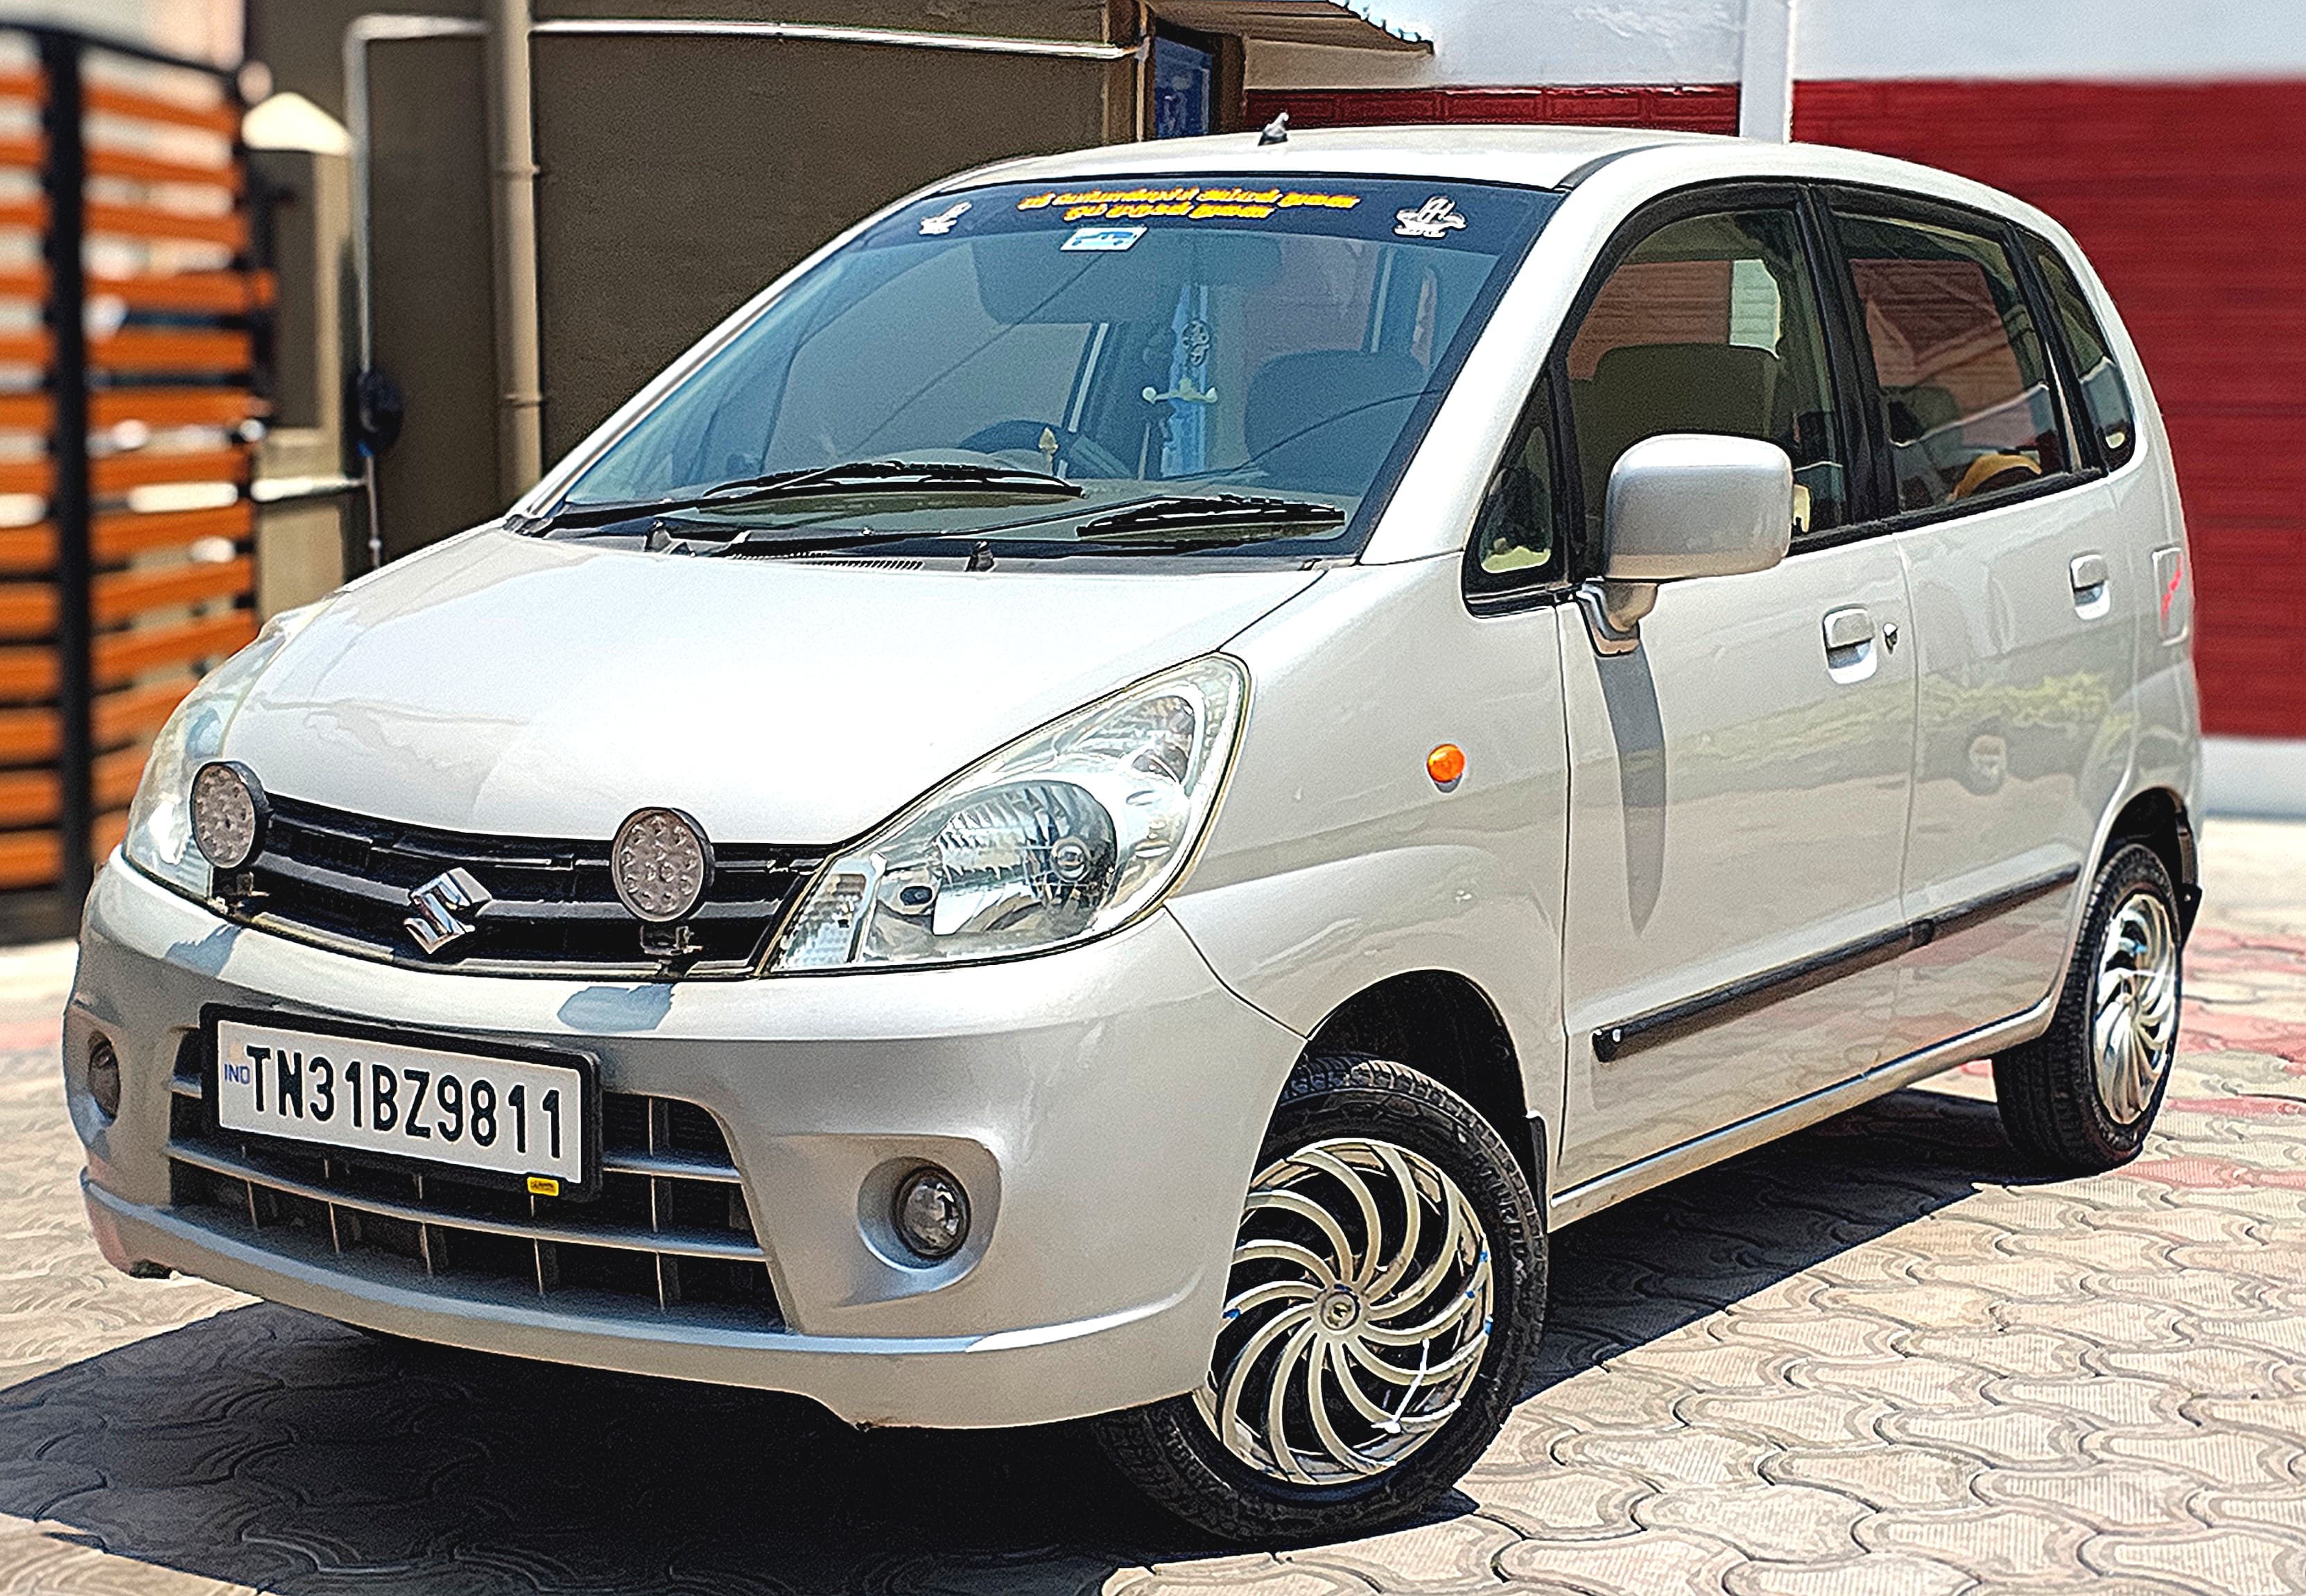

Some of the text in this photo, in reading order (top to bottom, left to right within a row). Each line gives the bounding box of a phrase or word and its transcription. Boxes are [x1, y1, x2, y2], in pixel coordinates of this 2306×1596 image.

[1277, 191, 1361, 208] துணை
[1105, 201, 1195, 218] முருகன்
[1188, 204, 1276, 220] துணை
[224, 1063, 251, 1085] IND
[245, 1044, 562, 1159] TN31BZ9811
